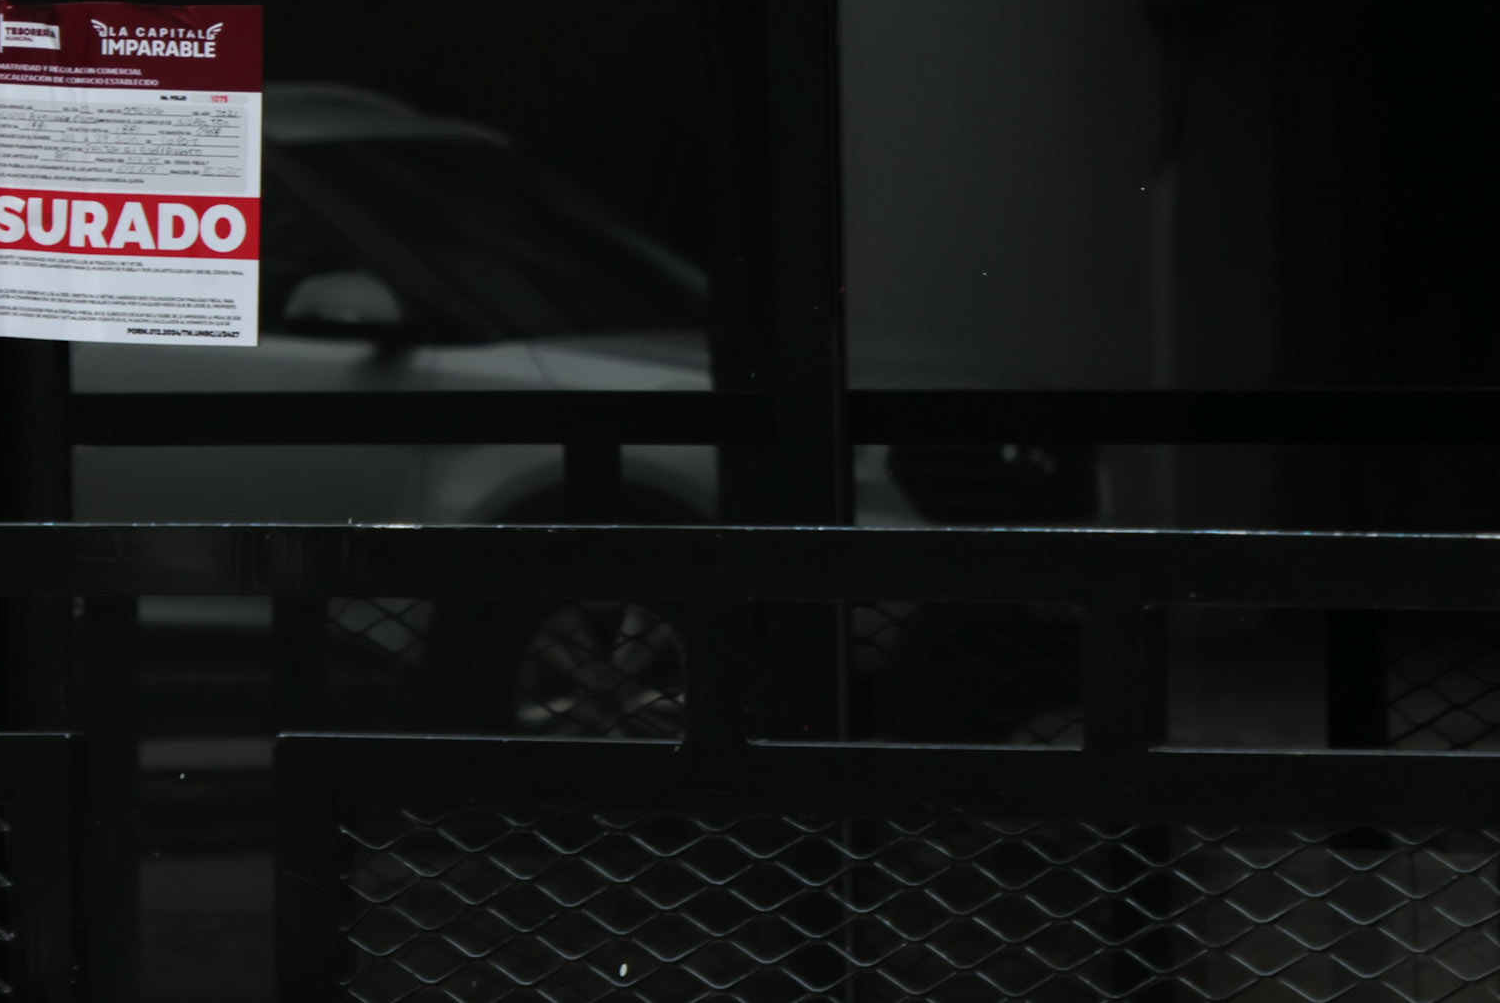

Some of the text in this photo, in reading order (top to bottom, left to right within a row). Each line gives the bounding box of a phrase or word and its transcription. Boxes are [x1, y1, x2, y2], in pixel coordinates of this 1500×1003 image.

[109, 27, 205, 39] LA CAPITAL
[101, 39, 216, 58] IMPARABLE
